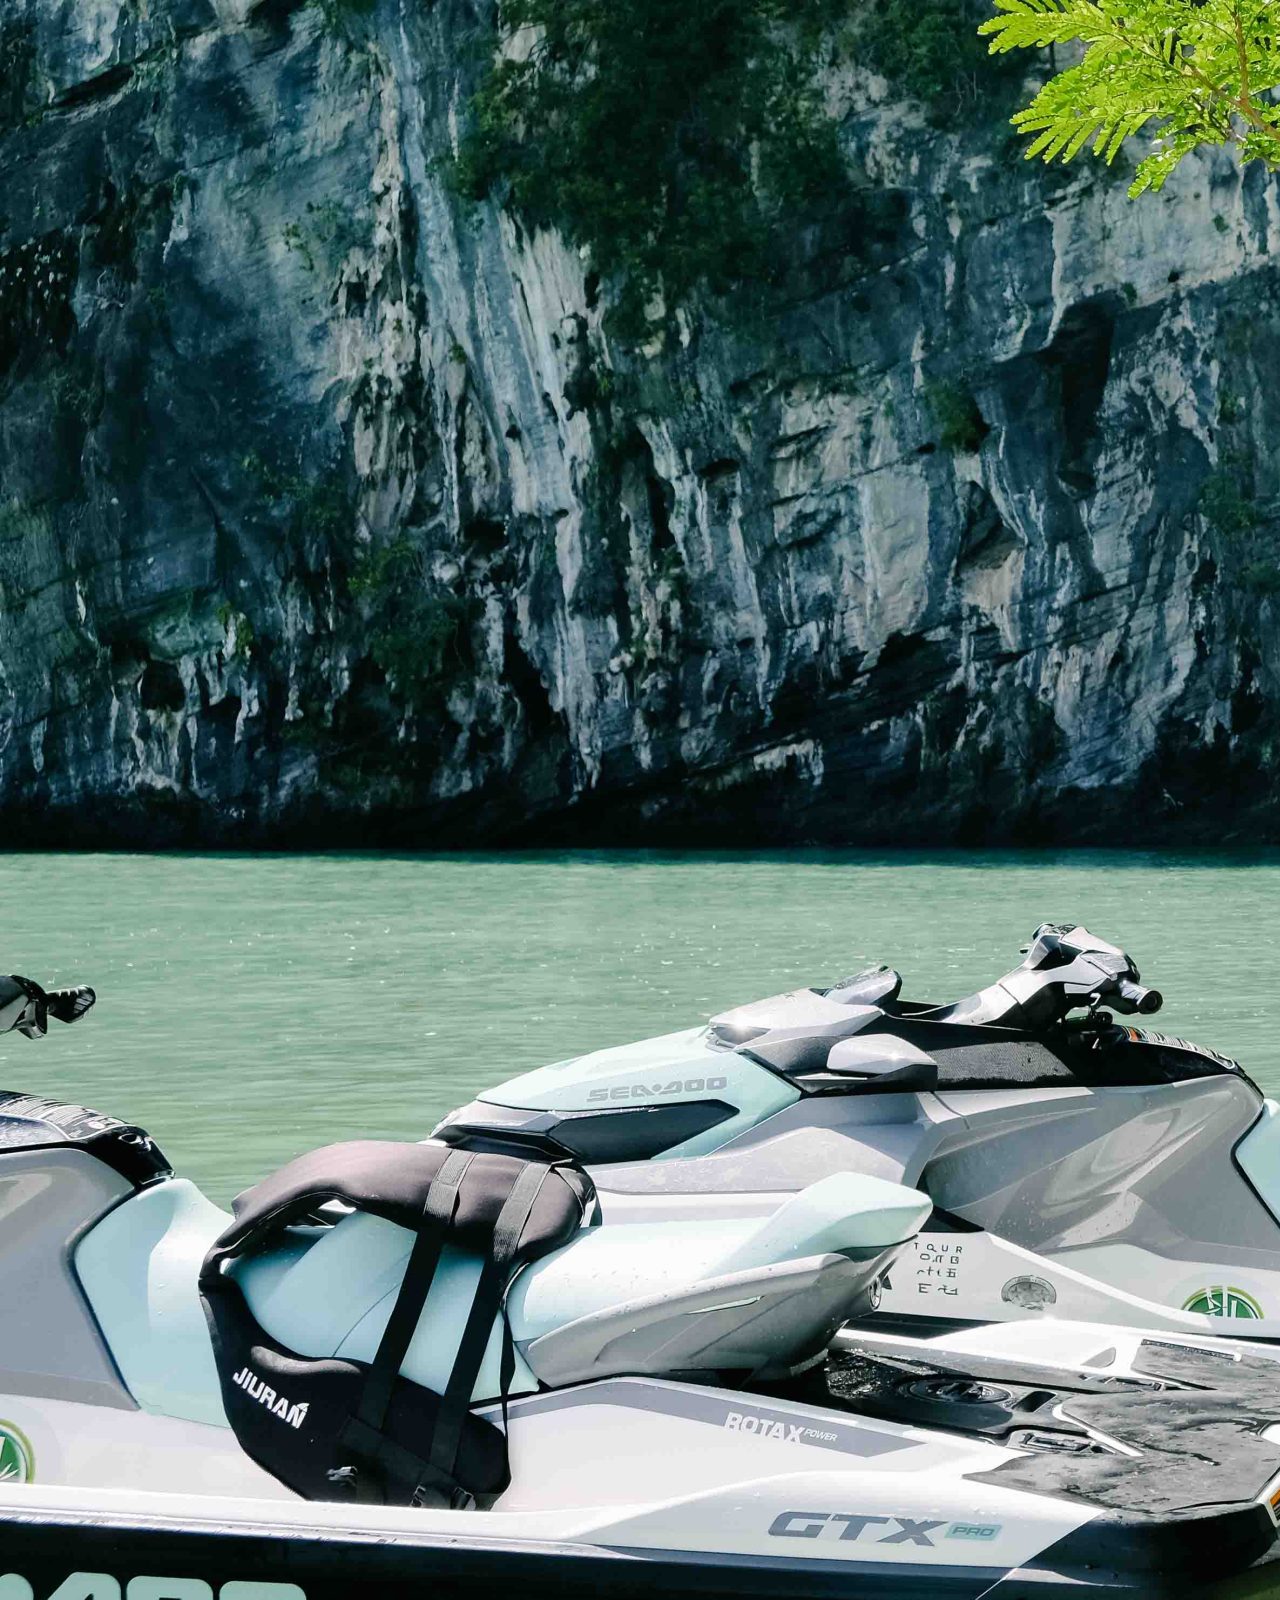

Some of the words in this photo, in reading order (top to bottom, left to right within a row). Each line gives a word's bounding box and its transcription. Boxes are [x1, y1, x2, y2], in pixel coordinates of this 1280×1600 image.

[723, 1412, 805, 1444] ROTAX
[803, 1428, 838, 1442] POWER
[767, 1511, 949, 1546] GTX
[951, 1526, 995, 1537] PRO
